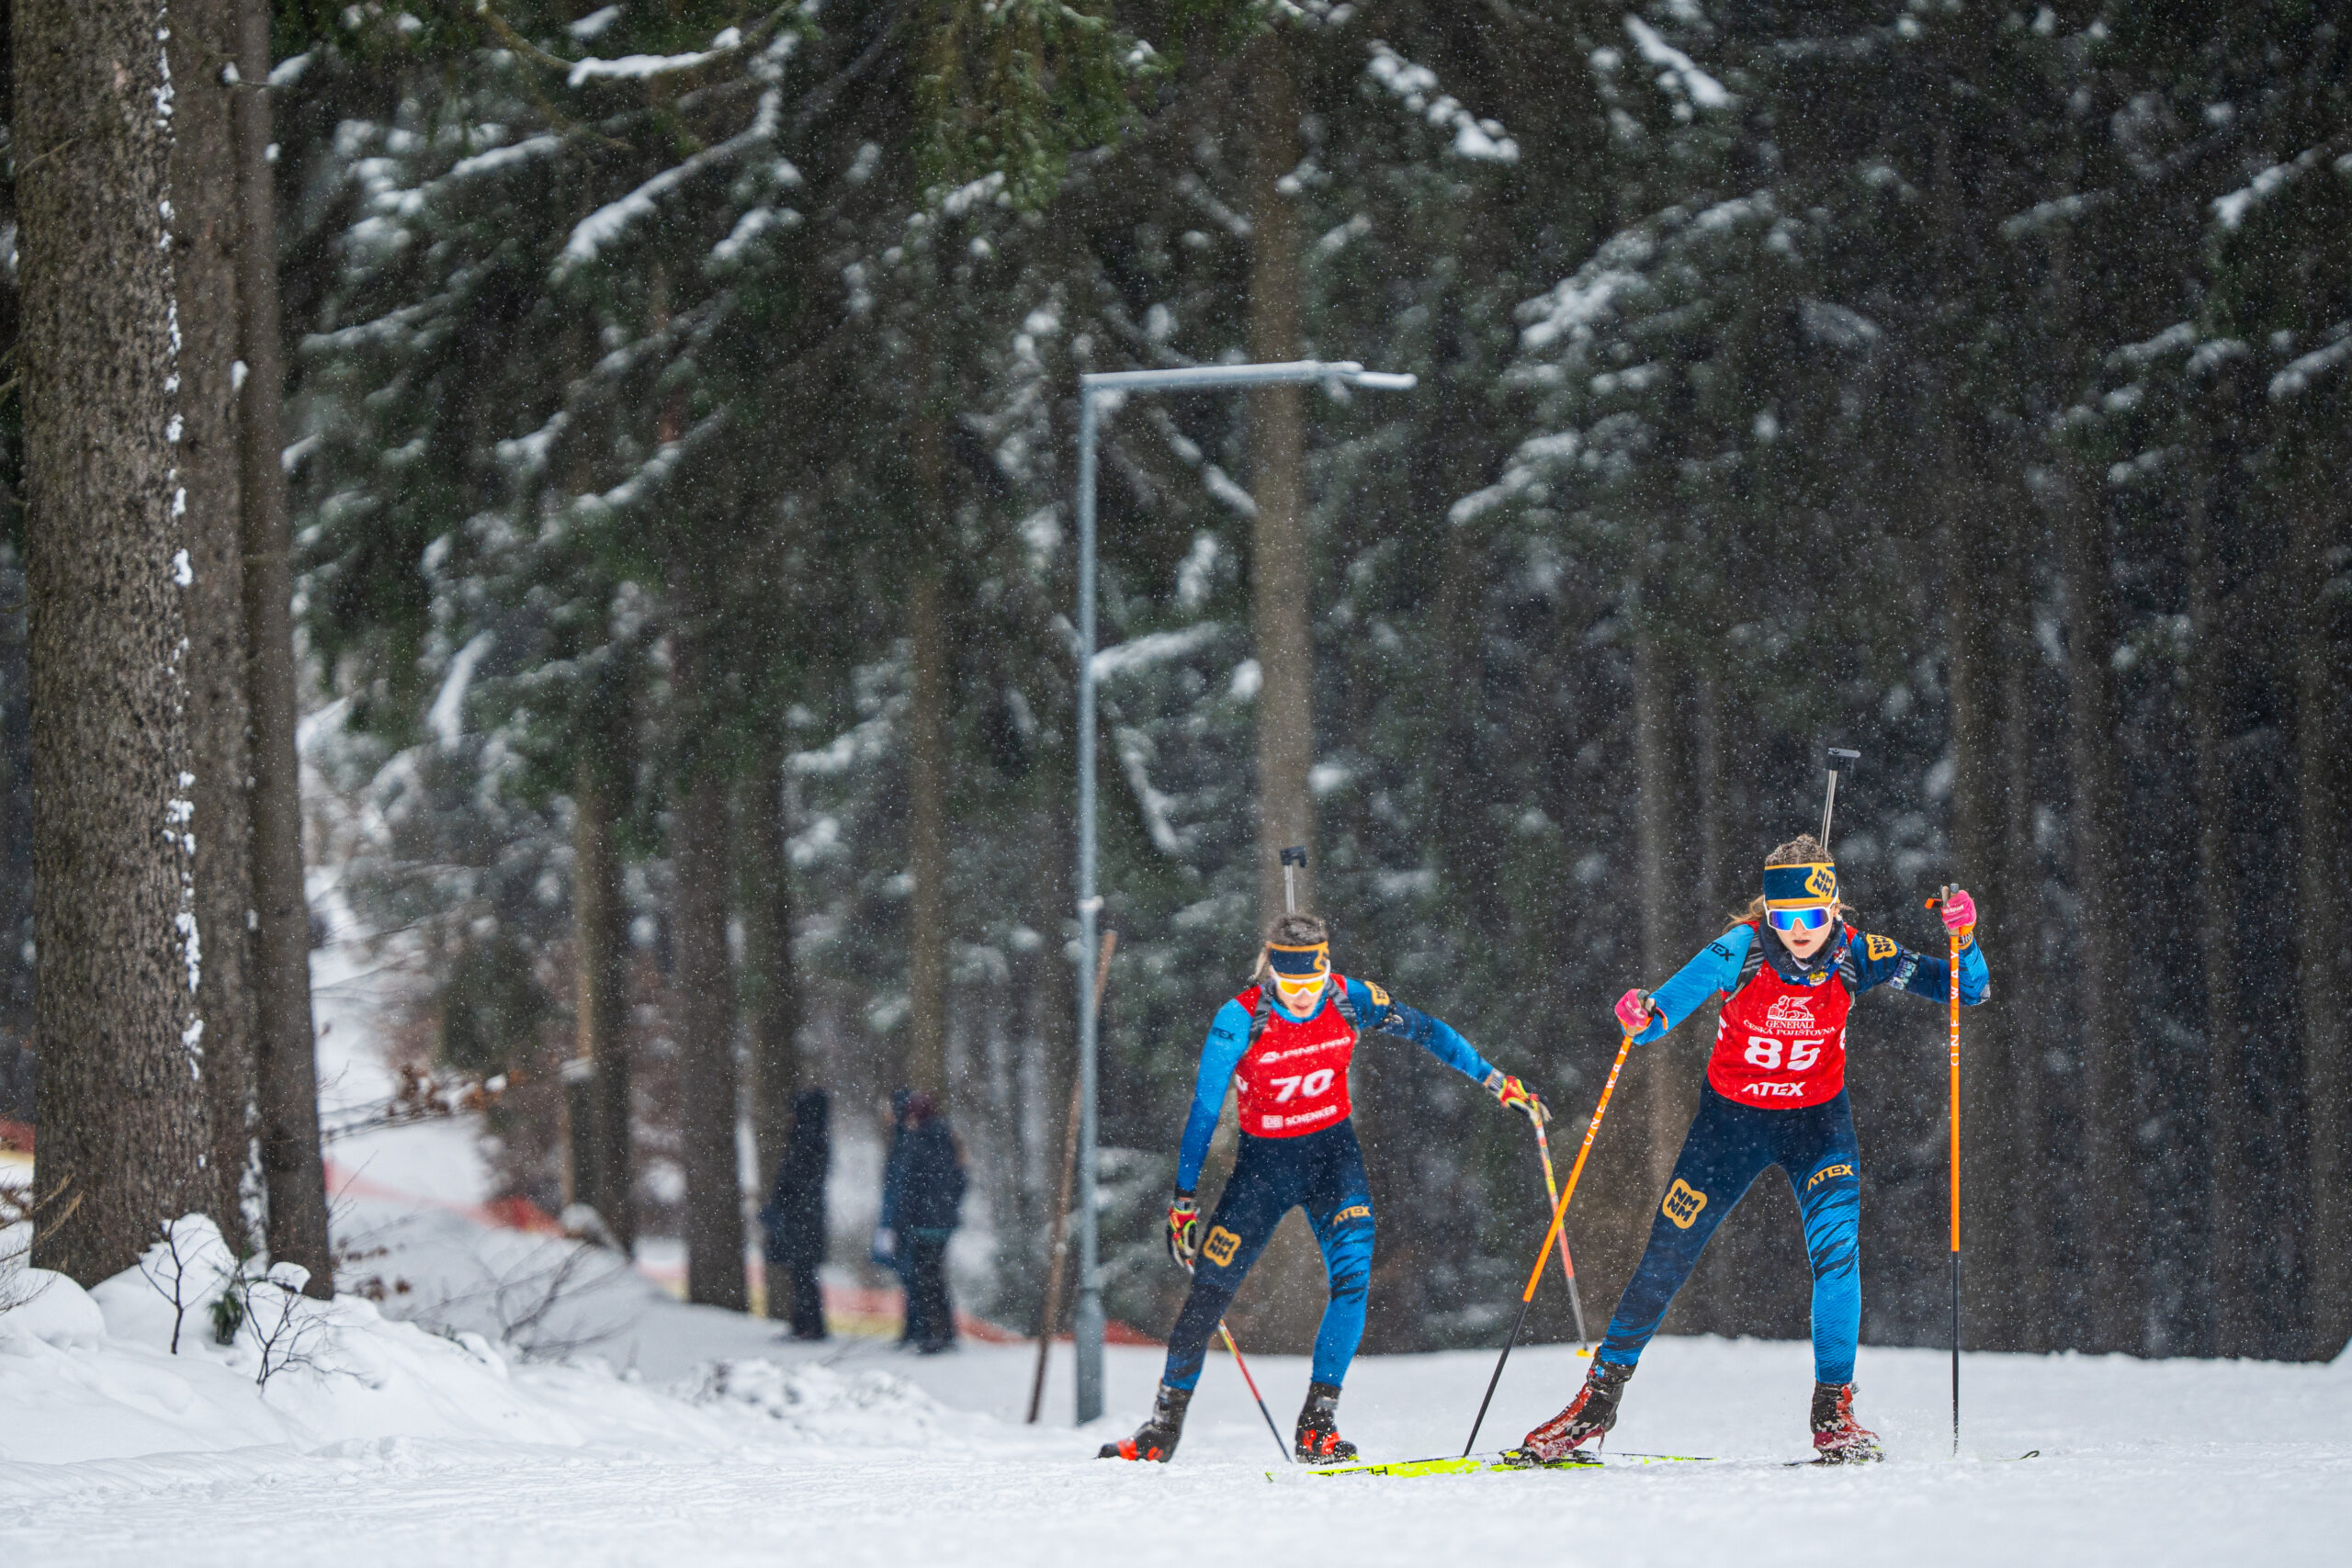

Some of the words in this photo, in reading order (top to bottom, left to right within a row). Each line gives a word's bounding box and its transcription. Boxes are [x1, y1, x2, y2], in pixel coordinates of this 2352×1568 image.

[1705, 942, 1736, 962] TEX
[1743, 1019, 1774, 1035] ČESKÁ
[1765, 1020, 1815, 1029] GENERALI
[1258, 1043, 1319, 1064] ALPINE
[1320, 1036, 1351, 1050] PRO
[1744, 1036, 1825, 1071] 85
[1269, 1067, 1335, 1102] 70
[1741, 1081, 1806, 1097] ATEX
[1263, 1116, 1282, 1127] DB
[1284, 1105, 1338, 1126] SCHENKER
[1807, 1164, 1854, 1190] ATEX
[1667, 1197, 1693, 1222] NM
[1674, 1186, 1701, 1211] NM
[1332, 1205, 1372, 1226] ATEX
